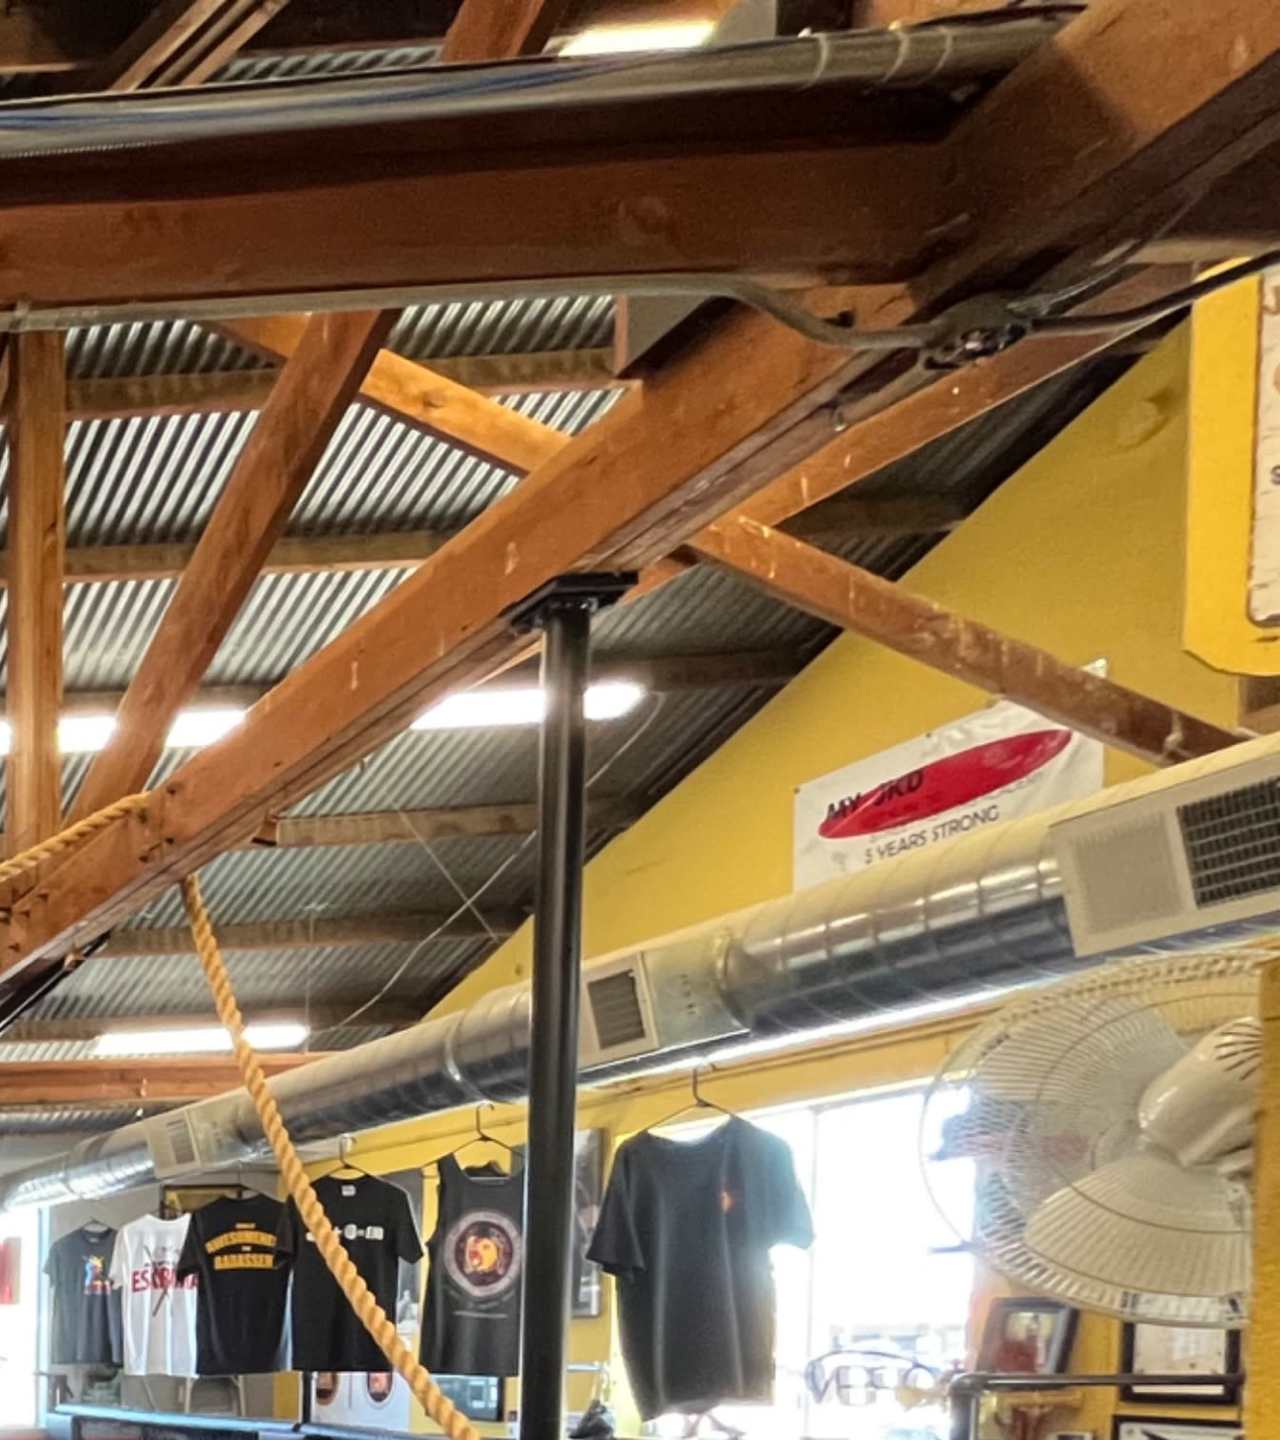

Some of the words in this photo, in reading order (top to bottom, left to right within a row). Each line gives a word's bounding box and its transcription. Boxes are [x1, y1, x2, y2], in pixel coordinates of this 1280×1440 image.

[827, 792, 861, 820] MY
[874, 769, 925, 806] JKD
[878, 830, 927, 860] YEARS
[932, 805, 1000, 842] STRONG
